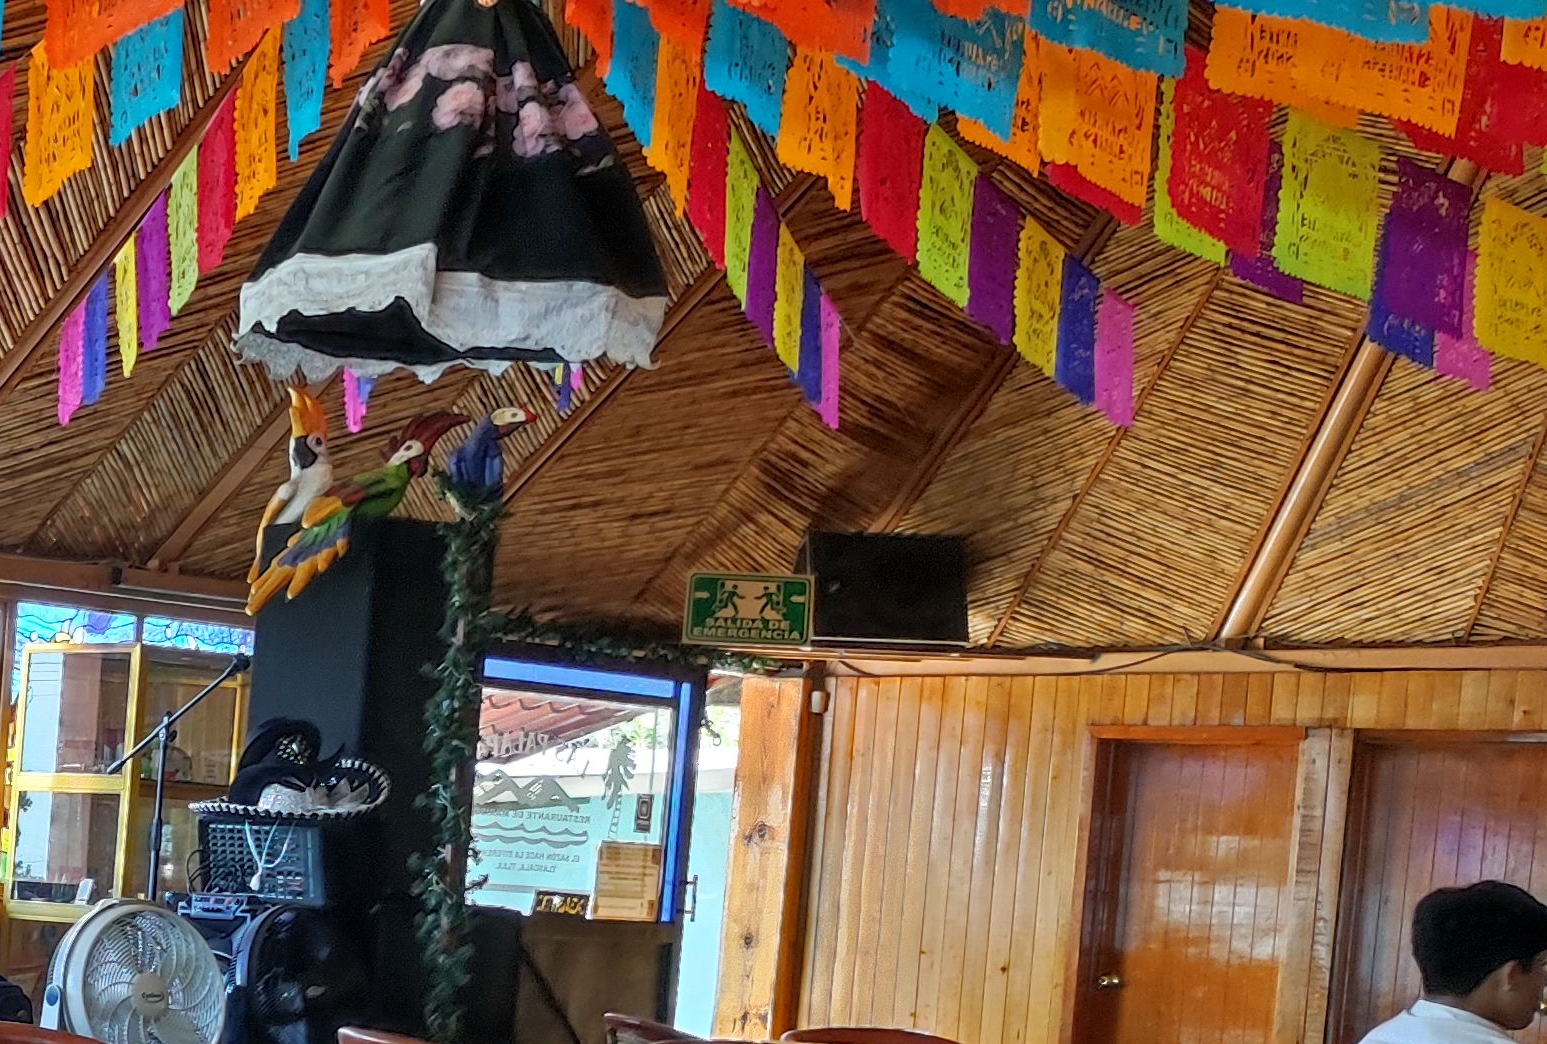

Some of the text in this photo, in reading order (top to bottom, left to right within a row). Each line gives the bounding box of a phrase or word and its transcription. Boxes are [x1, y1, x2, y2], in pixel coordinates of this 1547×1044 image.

[705, 617, 791, 631] SALIDA DE
[692, 627, 801, 640] EMERGENCIA
